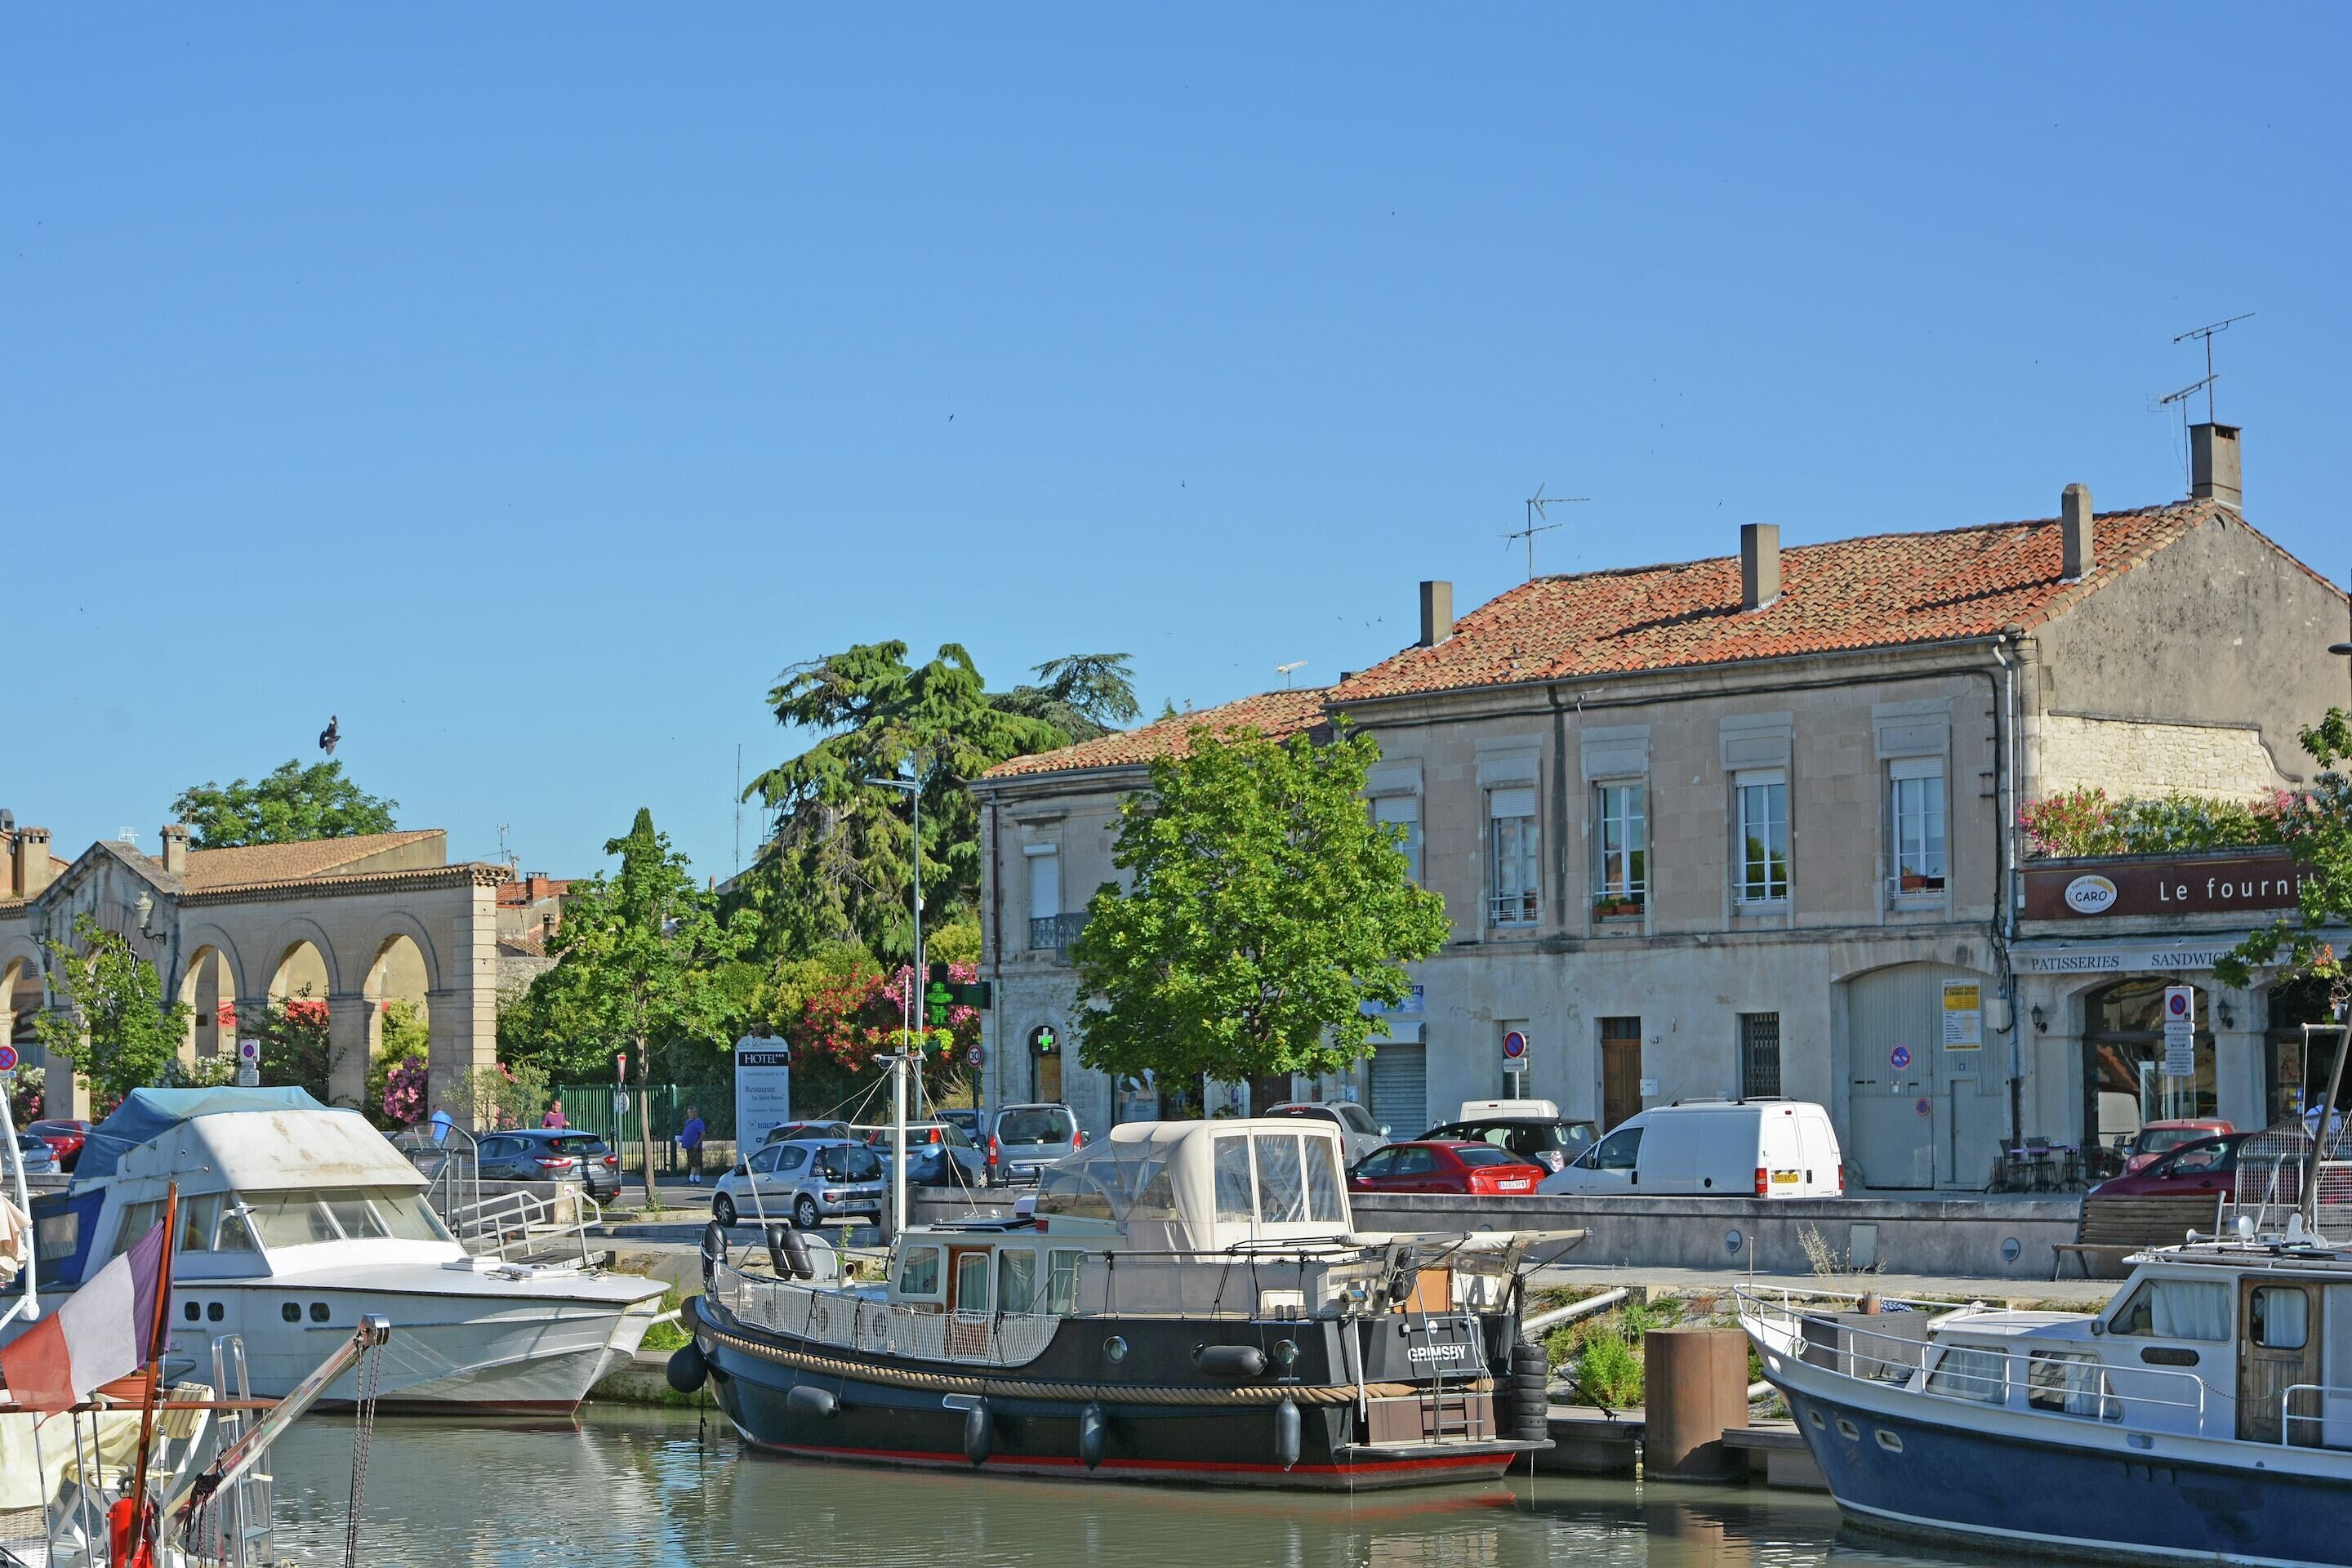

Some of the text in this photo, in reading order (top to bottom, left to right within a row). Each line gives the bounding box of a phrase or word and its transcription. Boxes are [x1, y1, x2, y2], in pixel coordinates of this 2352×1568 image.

[2075, 891, 2107, 902] CARO
[2160, 881, 2188, 902] Le
[2031, 956, 2119, 970] PATISSERIES
[2151, 951, 2249, 967] SANDWIC
[744, 1054, 777, 1064] HOTEL
[970, 1051, 979, 1061] 30
[1407, 1344, 1466, 1362] GRIMSBY
